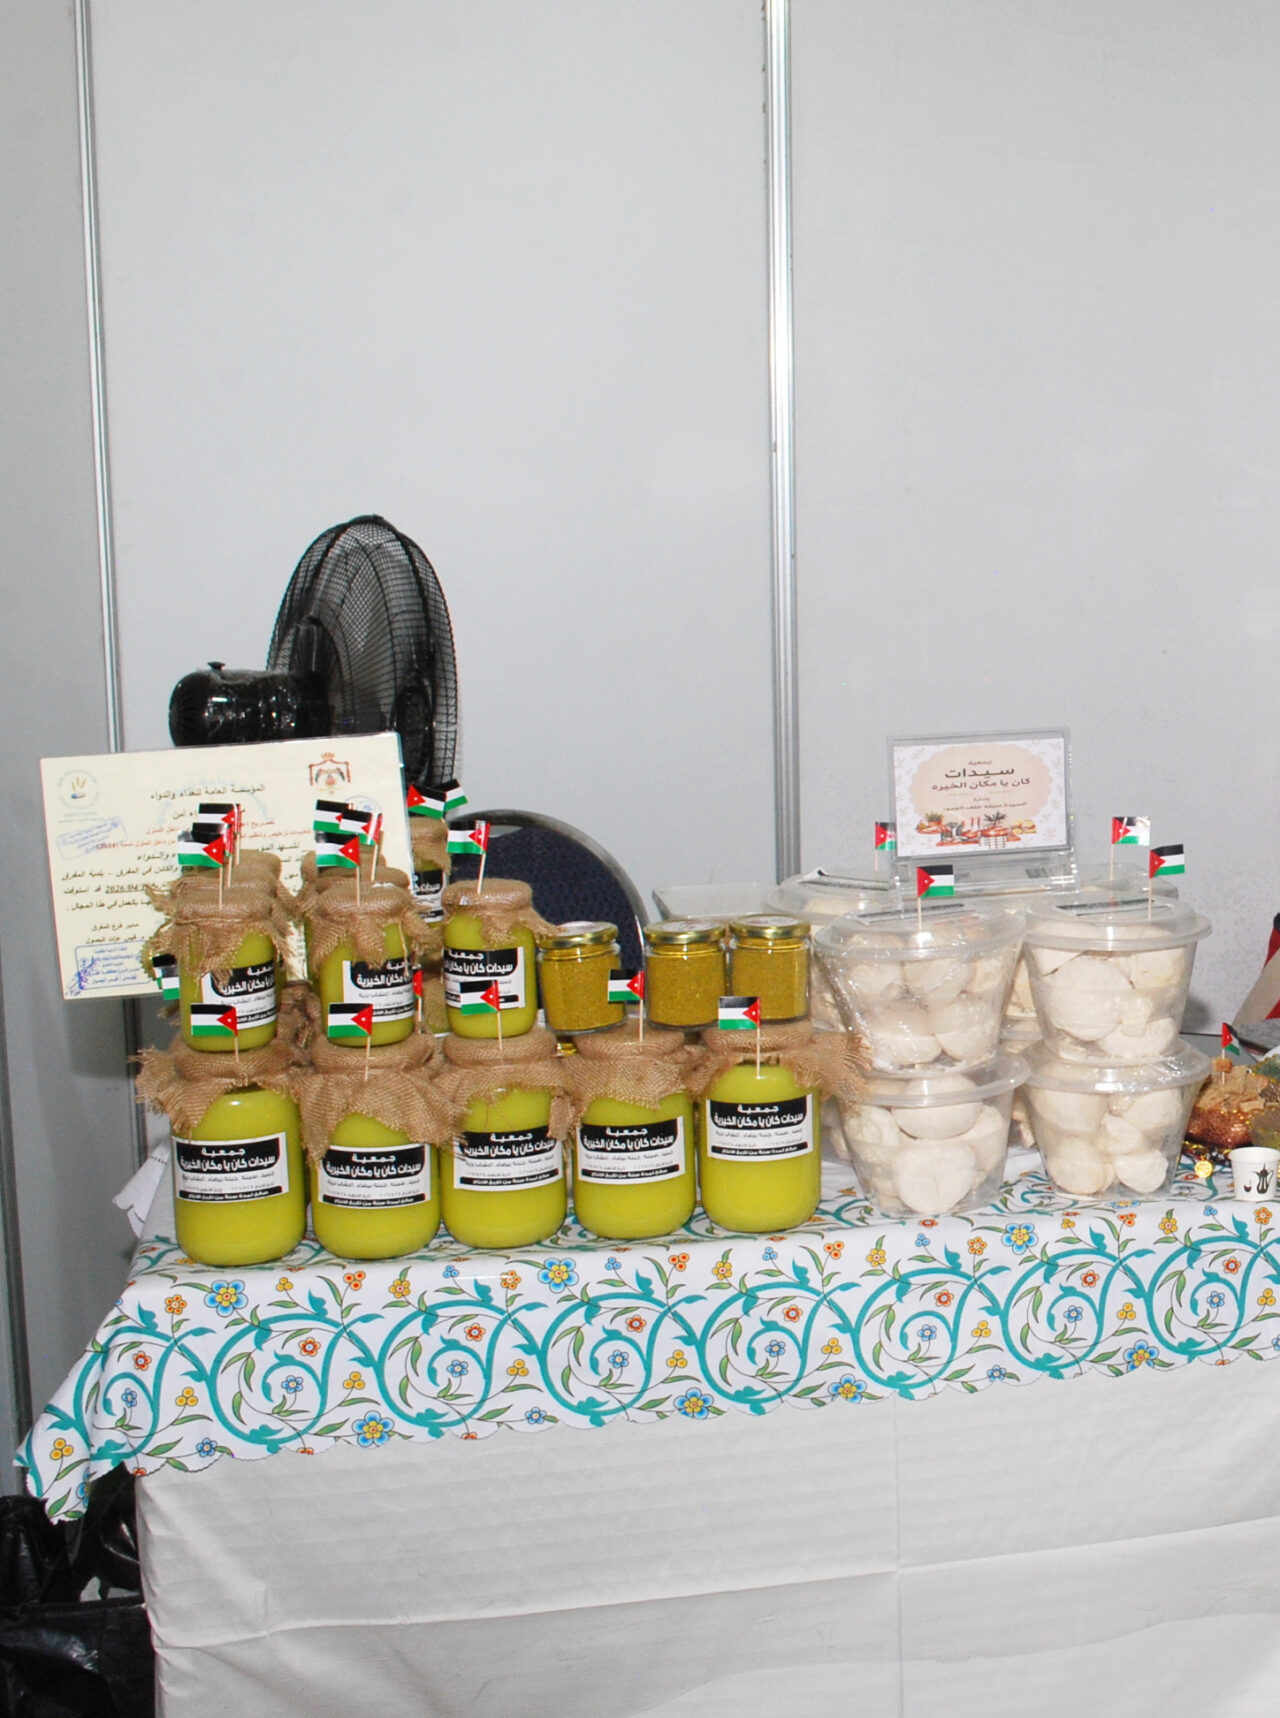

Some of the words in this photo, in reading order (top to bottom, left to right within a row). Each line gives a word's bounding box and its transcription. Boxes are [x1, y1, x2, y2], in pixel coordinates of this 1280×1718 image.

[944, 767, 1015, 779] سيدات
[969, 780, 998, 790] مكان
[1000, 779, 1009, 787] يا
[1011, 777, 1031, 788] كان
[469, 963, 486, 975] كان
[486, 962, 514, 975] سيدات
[356, 974, 386, 988] الخيرية
[737, 1104, 779, 1114] جمعية
[714, 1112, 737, 1127] الخيرية
[737, 1115, 758, 1128] مكان
[758, 1116, 765, 1128] يا
[765, 1114, 780, 1127] كان
[780, 1112, 804, 1124] سيدات
[490, 1133, 533, 1143] جمعية
[605, 1127, 649, 1137] جمعية
[534, 1139, 555, 1151] سيدات
[583, 1134, 605, 1150] الخيرية
[605, 1138, 626, 1151] مكان
[626, 1138, 634, 1151] يا
[634, 1137, 650, 1150] كان
[650, 1135, 674, 1147] سيدات
[201, 1147, 246, 1157] جمعية
[490, 1144, 512, 1157] مكان
[511, 1144, 520, 1156] يا
[520, 1142, 534, 1155] كان
[180, 1155, 201, 1170] الخيرية
[231, 1158, 248, 1171] كان
[248, 1155, 276, 1168] سيدات
[351, 1153, 396, 1164] جمعية
[201, 1159, 223, 1172] مكان
[223, 1159, 230, 1171] يا
[326, 1161, 350, 1176] الخيرية
[351, 1164, 373, 1178] مكان
[397, 1163, 421, 1175] سيدات
[373, 1166, 381, 1178] يا
[381, 1165, 397, 1178] كان
